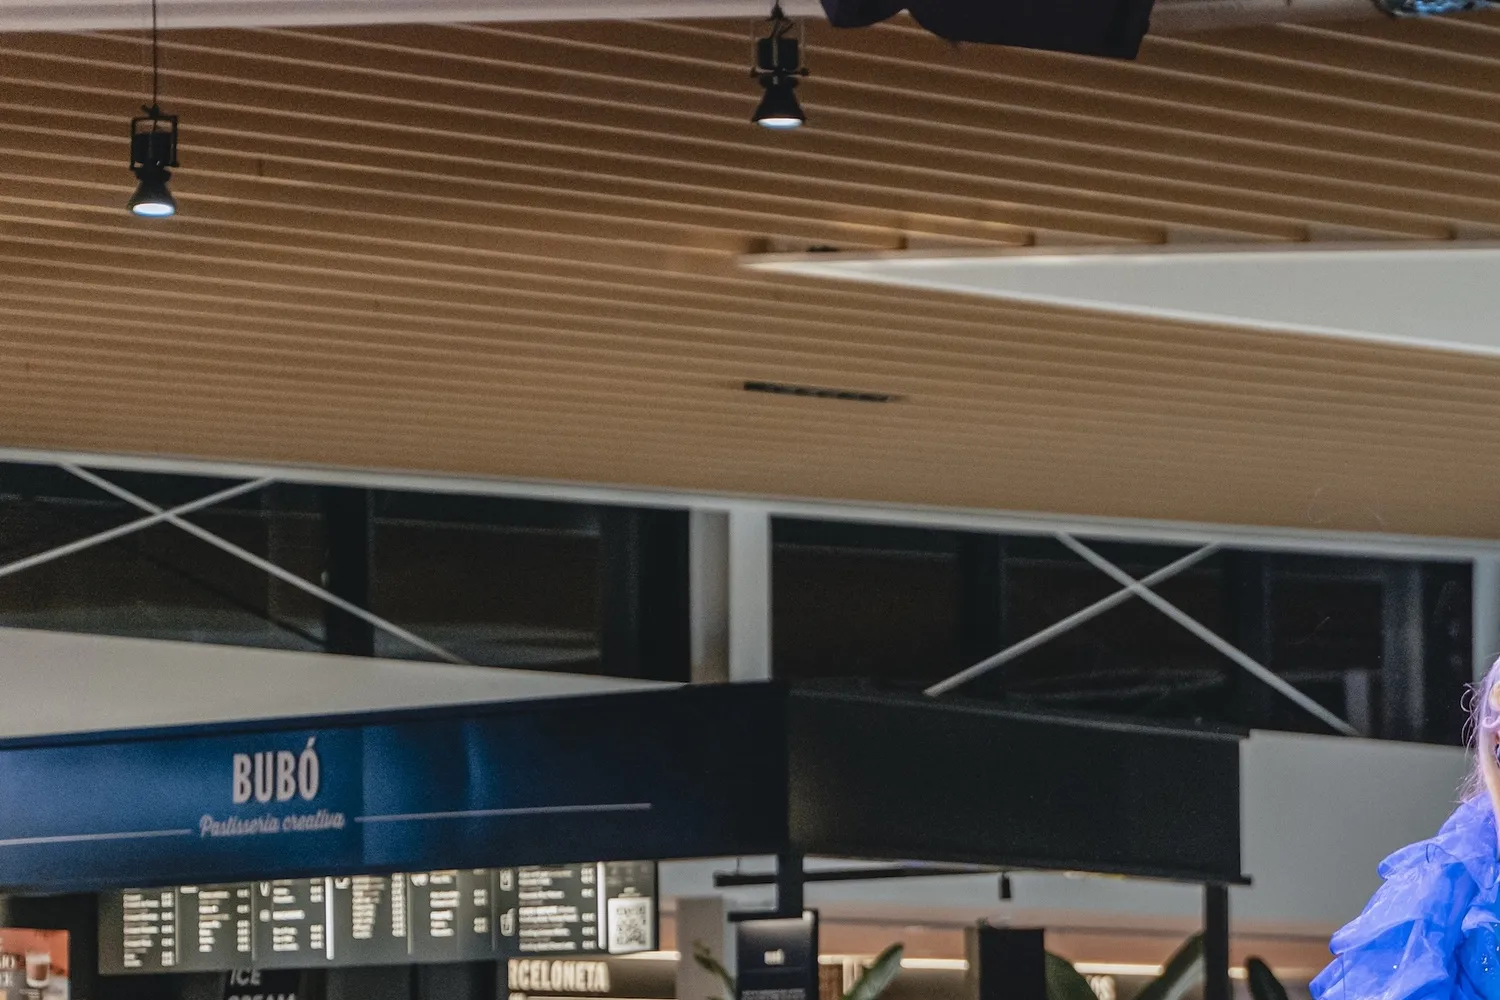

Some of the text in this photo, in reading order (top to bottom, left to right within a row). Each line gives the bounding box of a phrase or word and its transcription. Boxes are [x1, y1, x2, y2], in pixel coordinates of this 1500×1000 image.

[233, 736, 320, 804] BUBÓ
[199, 808, 346, 838] Pastisseria creativa
[230, 967, 262, 986] ICE
